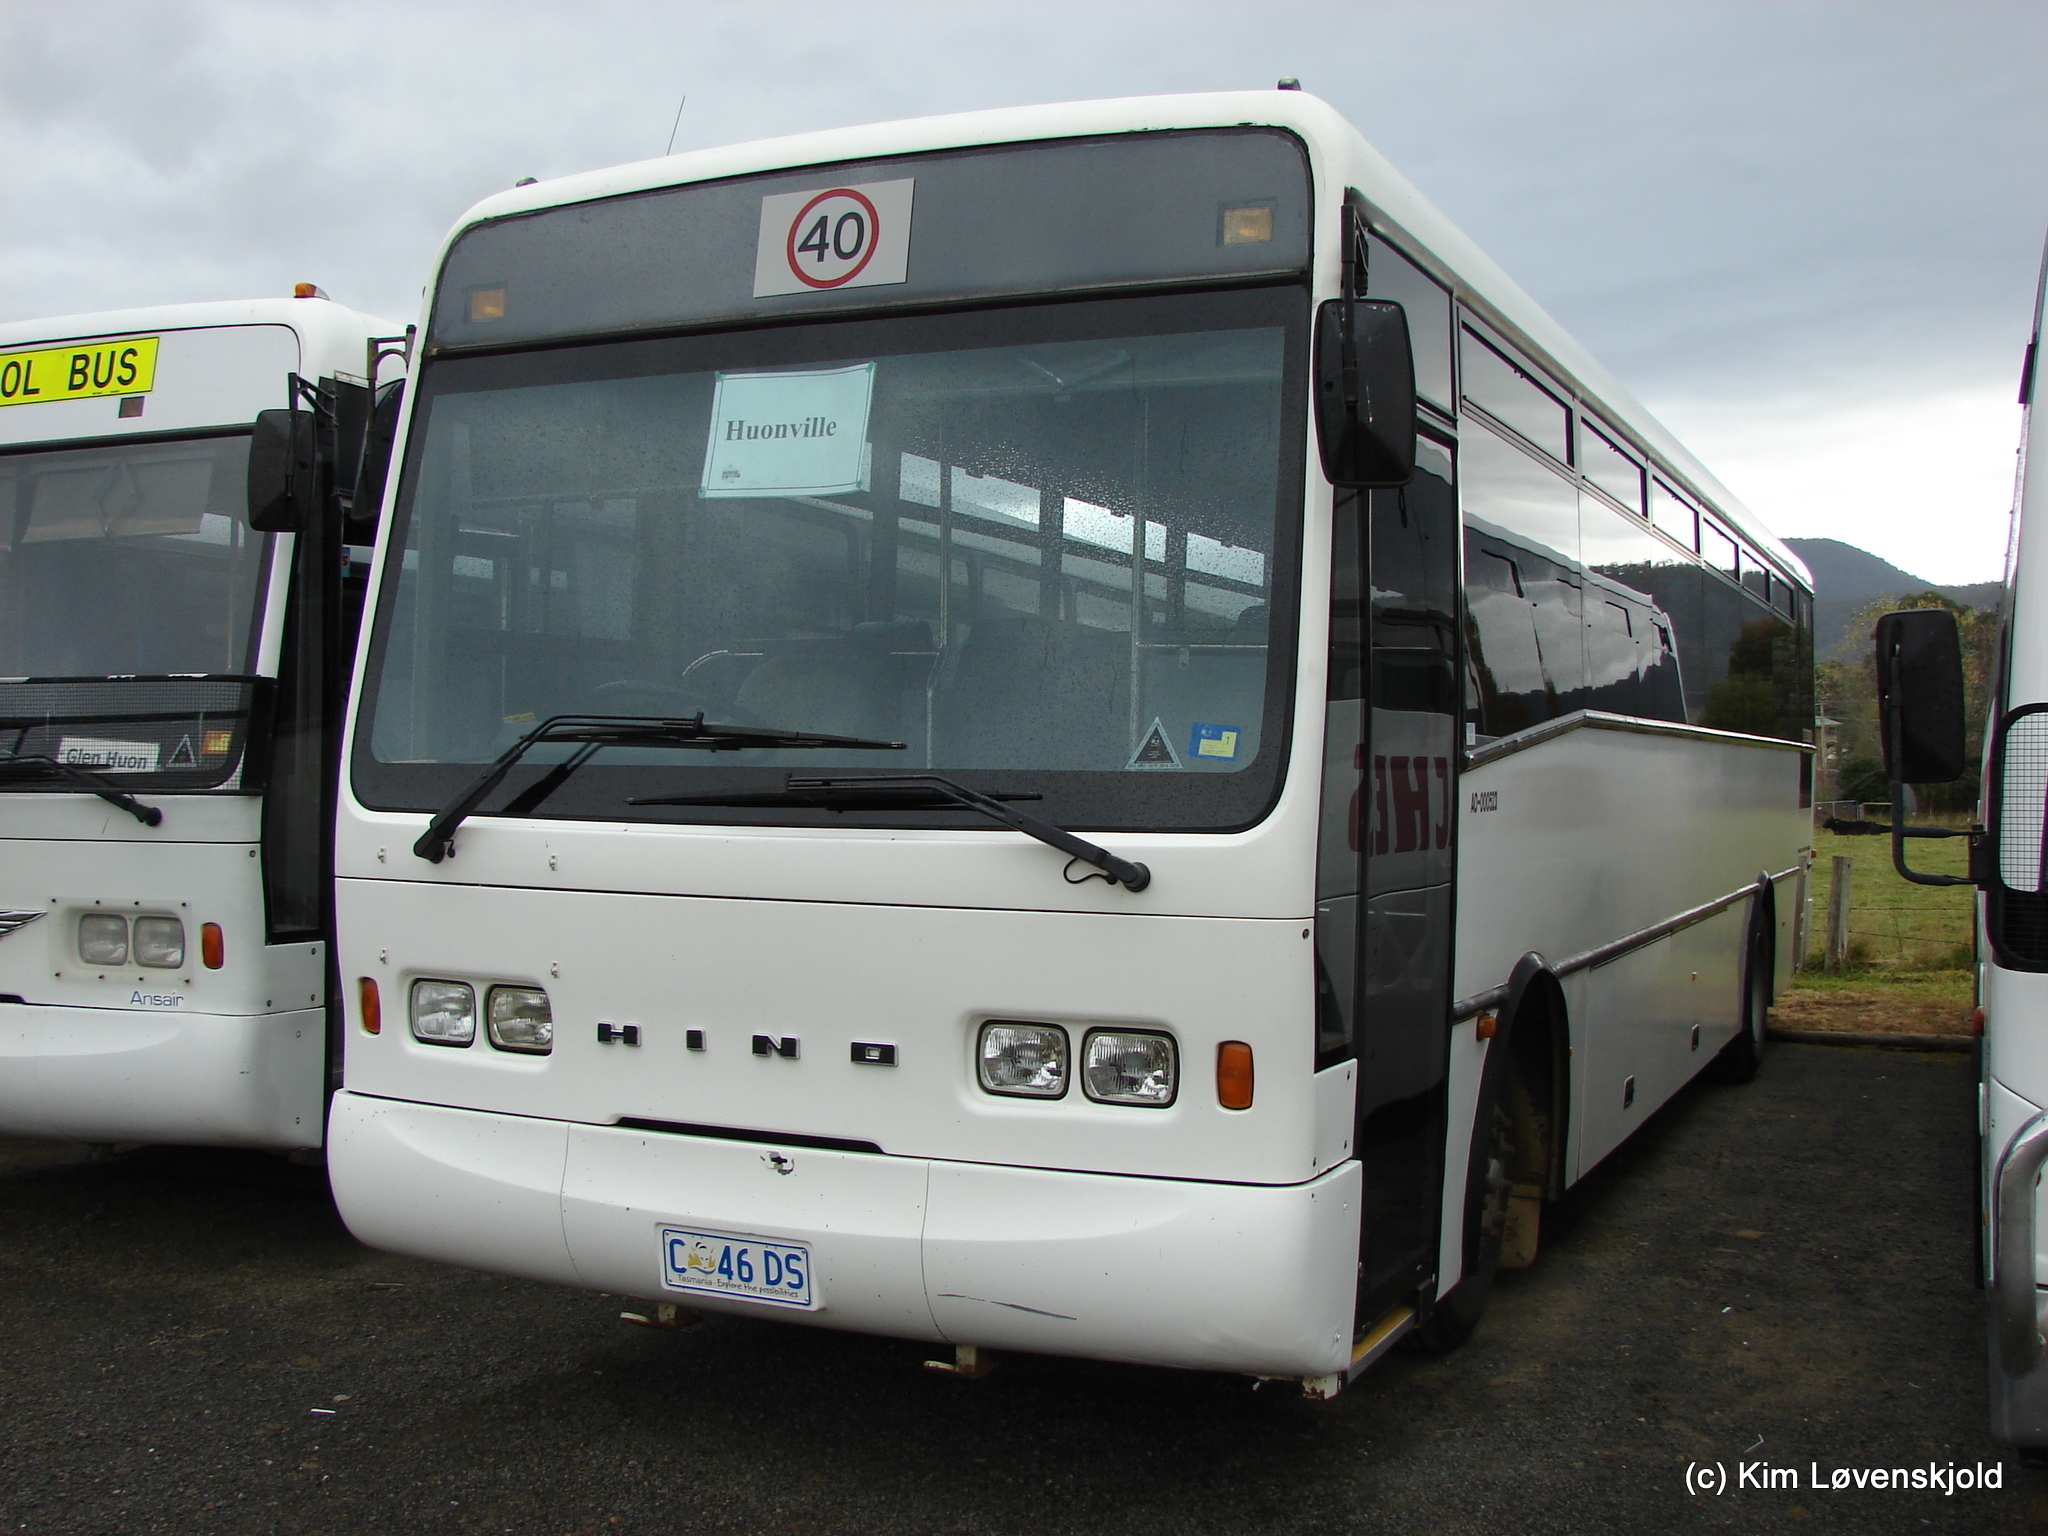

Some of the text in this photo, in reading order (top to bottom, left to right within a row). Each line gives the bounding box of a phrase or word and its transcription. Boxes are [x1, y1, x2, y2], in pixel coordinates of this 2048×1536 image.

[798, 211, 864, 262] 40
[68, 347, 138, 391] BUS
[725, 416, 837, 441] Huonville
[67, 748, 147, 769] Glen Huon
[130, 990, 184, 1007] Ansair
[597, 1021, 899, 1067] HINO
[669, 1238, 804, 1289] C 46 DS
[677, 1273, 799, 1299] Tasmania Explore the possibilities
